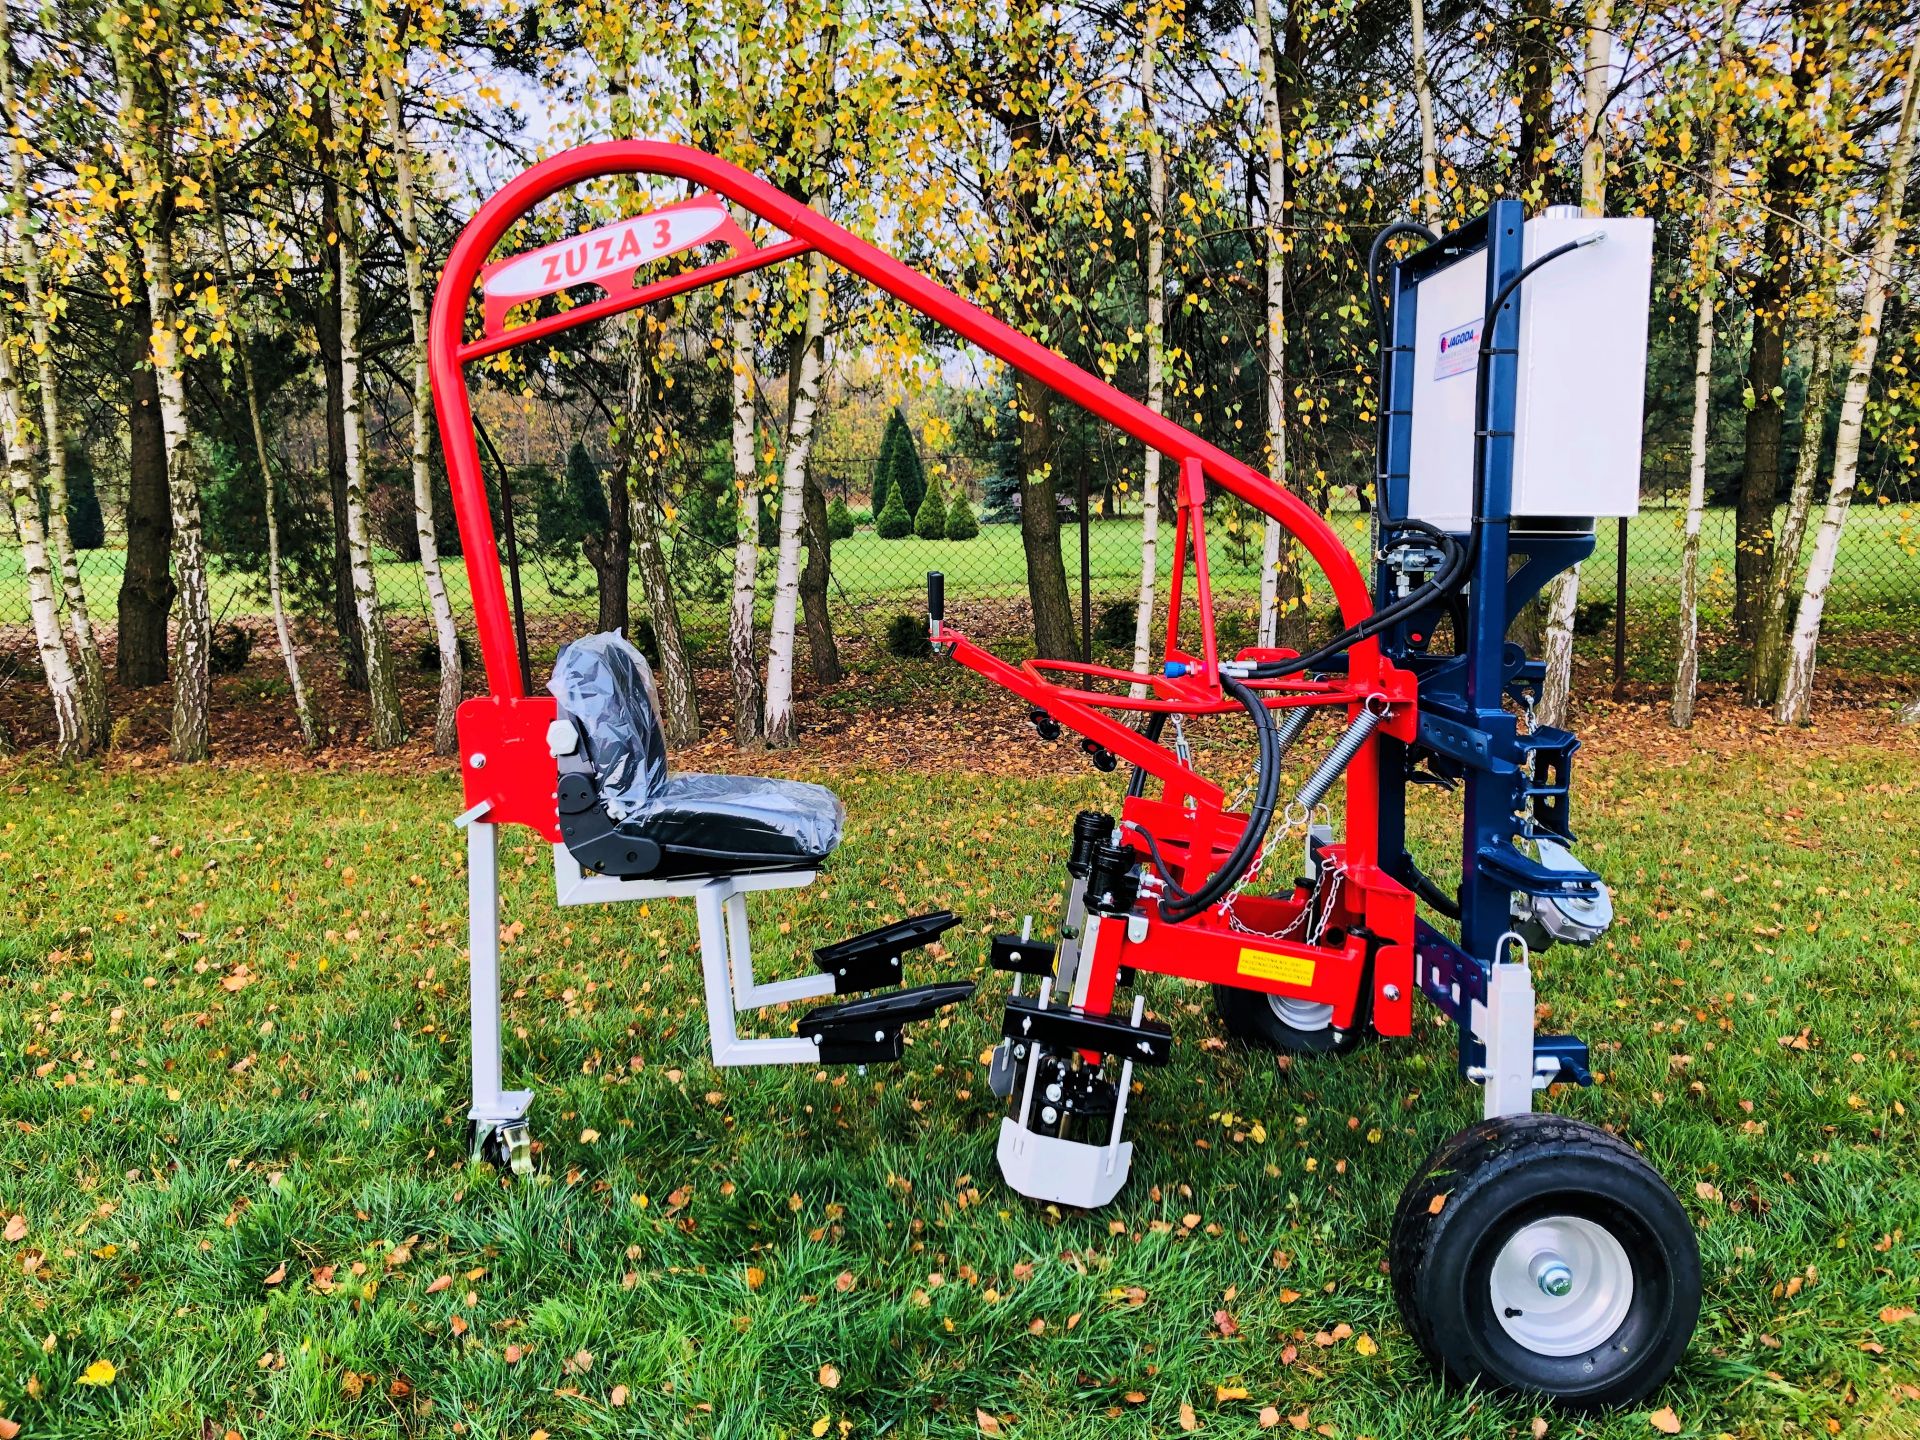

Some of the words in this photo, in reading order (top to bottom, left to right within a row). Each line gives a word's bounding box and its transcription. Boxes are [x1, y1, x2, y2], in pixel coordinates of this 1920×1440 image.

[541, 229, 641, 286] ZUZA
[653, 219, 671, 250] 3
[1448, 329, 1474, 348] JAGODA
